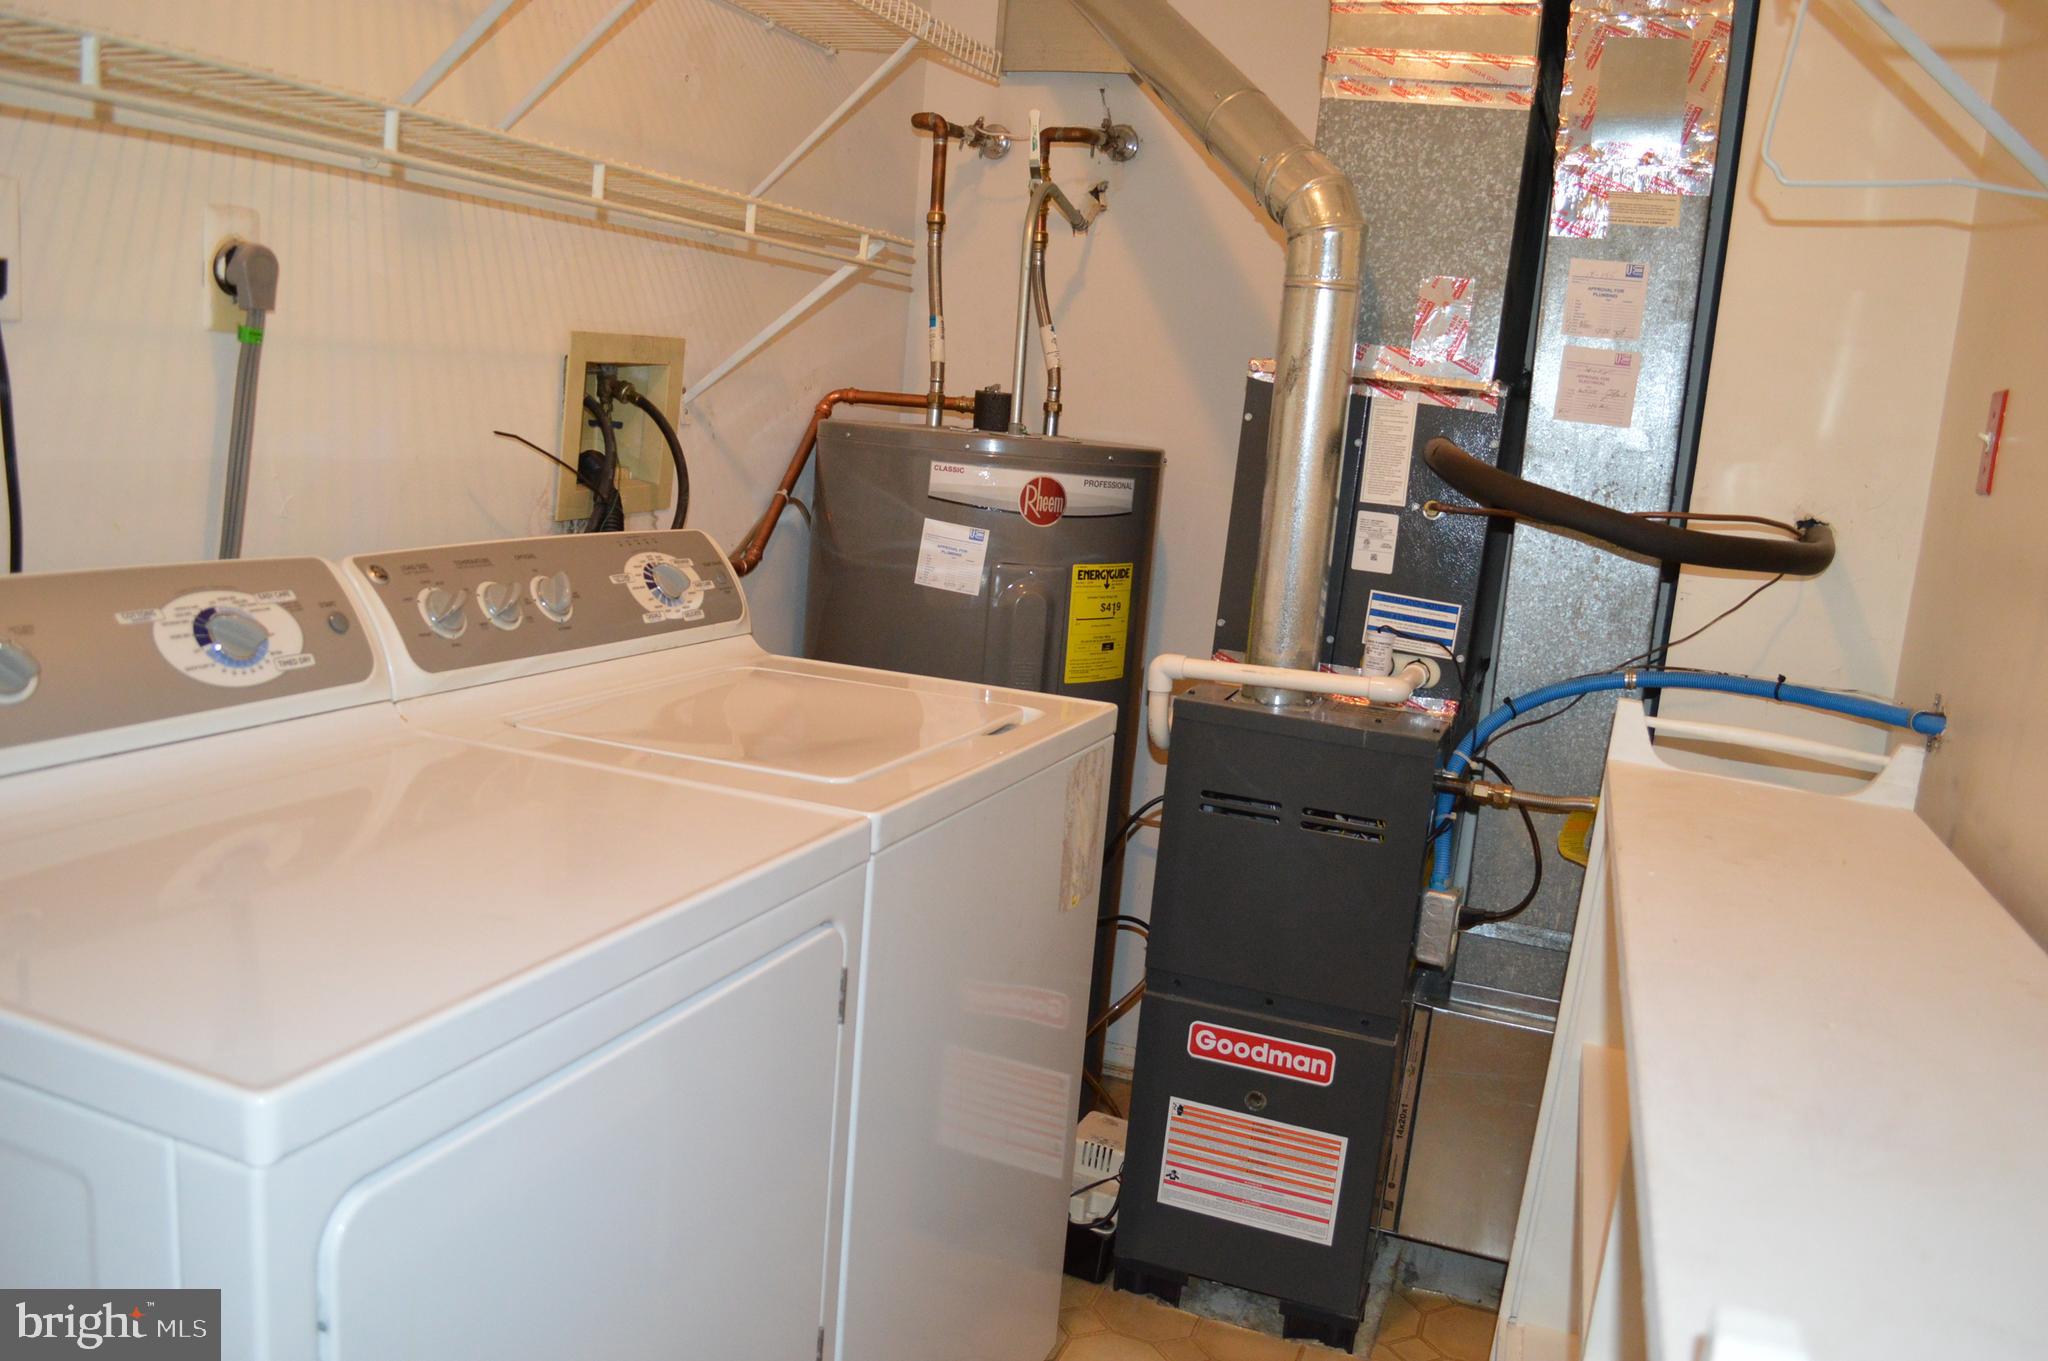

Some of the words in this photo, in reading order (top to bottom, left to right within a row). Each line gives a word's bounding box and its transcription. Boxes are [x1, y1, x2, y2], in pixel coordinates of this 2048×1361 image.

[933, 464, 965, 474] CLASSIC
[1083, 479, 1133, 490] PROFESSIONAL
[1023, 477, 1064, 519] Rheem
[1077, 567, 1131, 581] ENERGYGUIDE
[277, 658, 298, 667] TIMED
[1195, 1029, 1327, 1076] Goodman
